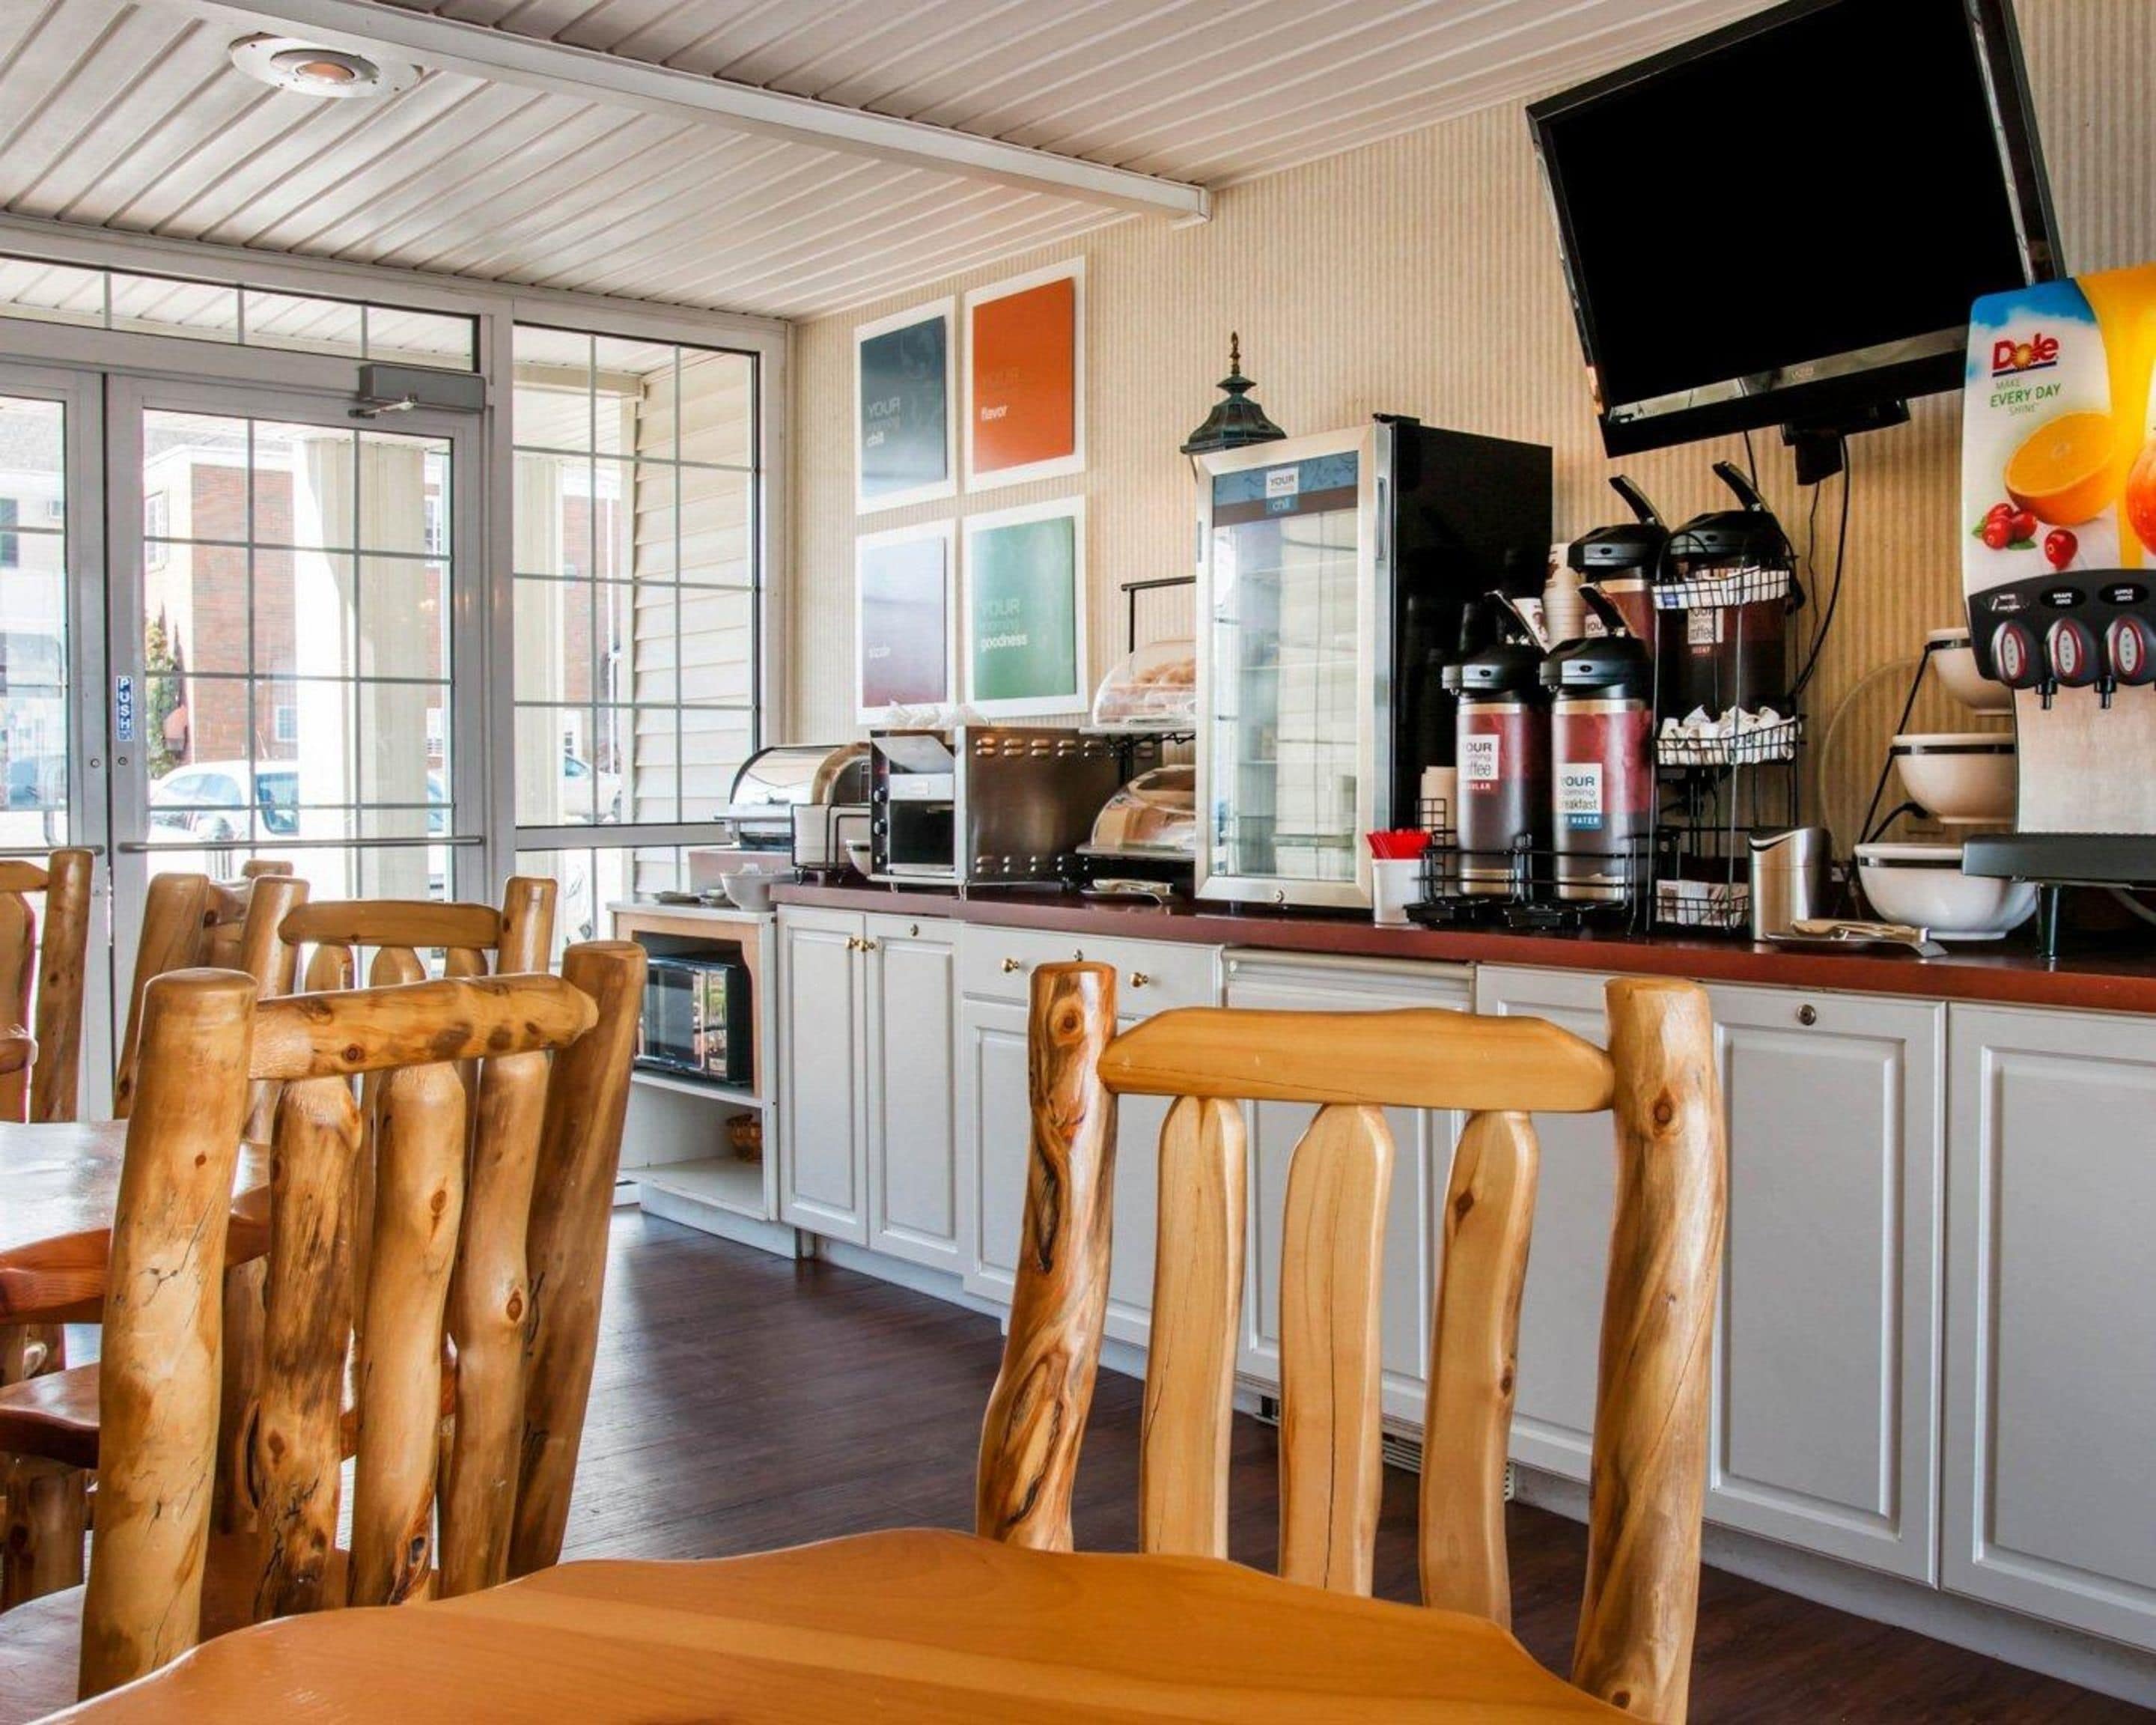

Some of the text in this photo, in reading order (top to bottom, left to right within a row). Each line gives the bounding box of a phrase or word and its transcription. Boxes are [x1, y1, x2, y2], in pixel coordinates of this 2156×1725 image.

[1992, 332, 2059, 370] Dole
[1991, 383, 2061, 408] EVERY DAY
[868, 396, 900, 419] YOUR
[981, 405, 1008, 422] flavor
[1270, 474, 1294, 487] YOUR
[981, 633, 1028, 653] goodness
[120, 676, 132, 731] PUSH
